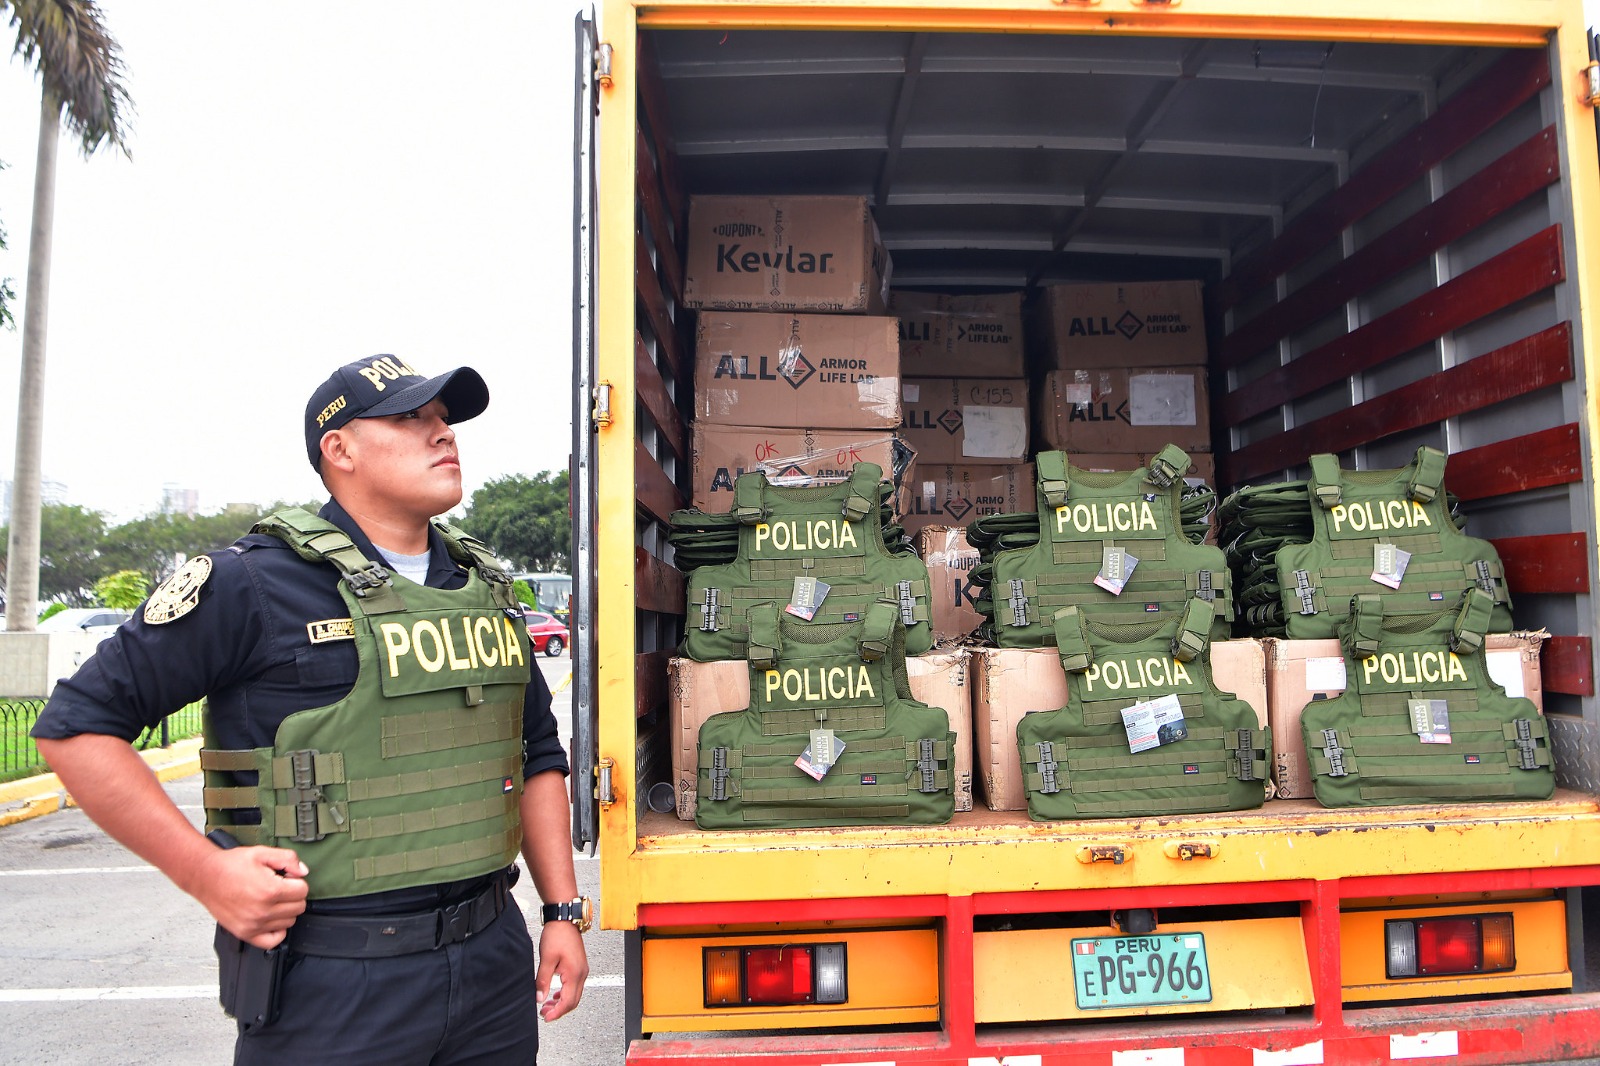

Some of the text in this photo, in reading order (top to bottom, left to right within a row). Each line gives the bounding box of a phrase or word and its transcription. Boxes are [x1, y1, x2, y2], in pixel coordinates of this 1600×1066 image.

[718, 223, 757, 238] DUPONT
[716, 244, 833, 274] Kevlar
[967, 323, 1003, 333] ARMOR
[1068, 317, 1116, 337] ALL
[1146, 314, 1181, 324] ARMOR
[1146, 325, 1168, 334] LIFE
[968, 334, 989, 343] LIFE
[713, 354, 778, 381] ALL
[819, 358, 868, 371] ARMOR
[819, 372, 848, 384] LIFE
[315, 394, 348, 429] PERU
[1069, 402, 1116, 422] ALL
[755, 440, 780, 462] OK
[836, 446, 863, 465] OK
[908, 496, 944, 515] LL
[1331, 500, 1431, 532] POLICIA
[1055, 501, 1158, 533] POLICIA
[755, 520, 858, 551] POLICIA
[380, 616, 524, 678] POLICIA
[1084, 657, 1193, 691] POLICIA
[1363, 651, 1468, 685] POLICIA
[765, 665, 875, 702] POLICIA
[962, 773, 970, 795] ALL
[1277, 763, 1287, 785] ALL
[1115, 938, 1161, 954] PERU
